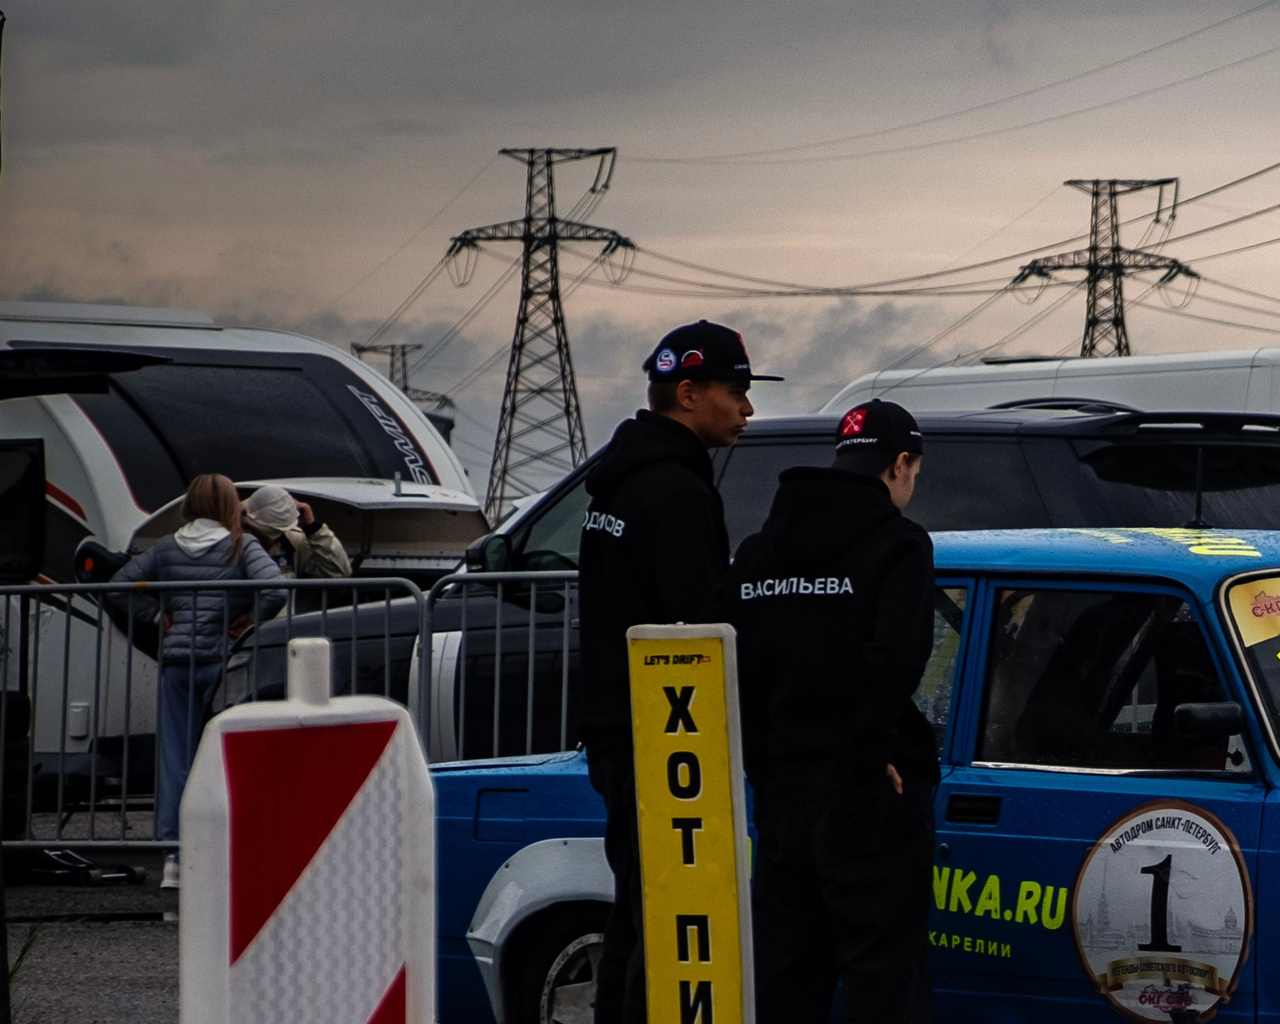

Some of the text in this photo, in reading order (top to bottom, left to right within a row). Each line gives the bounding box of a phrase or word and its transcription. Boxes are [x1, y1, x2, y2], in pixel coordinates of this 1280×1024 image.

[740, 577, 854, 600] ВАСИЛЬЕВА
[644, 655, 670, 665] LET'S
[662, 686, 703, 867] ХОТ
[1109, 816, 1221, 855] АВТОДРОМ САНКТ-ПЕТЕРБУРГ
[1138, 854, 1182, 952] 1
[929, 930, 1011, 958] КАРЕЛИИ
